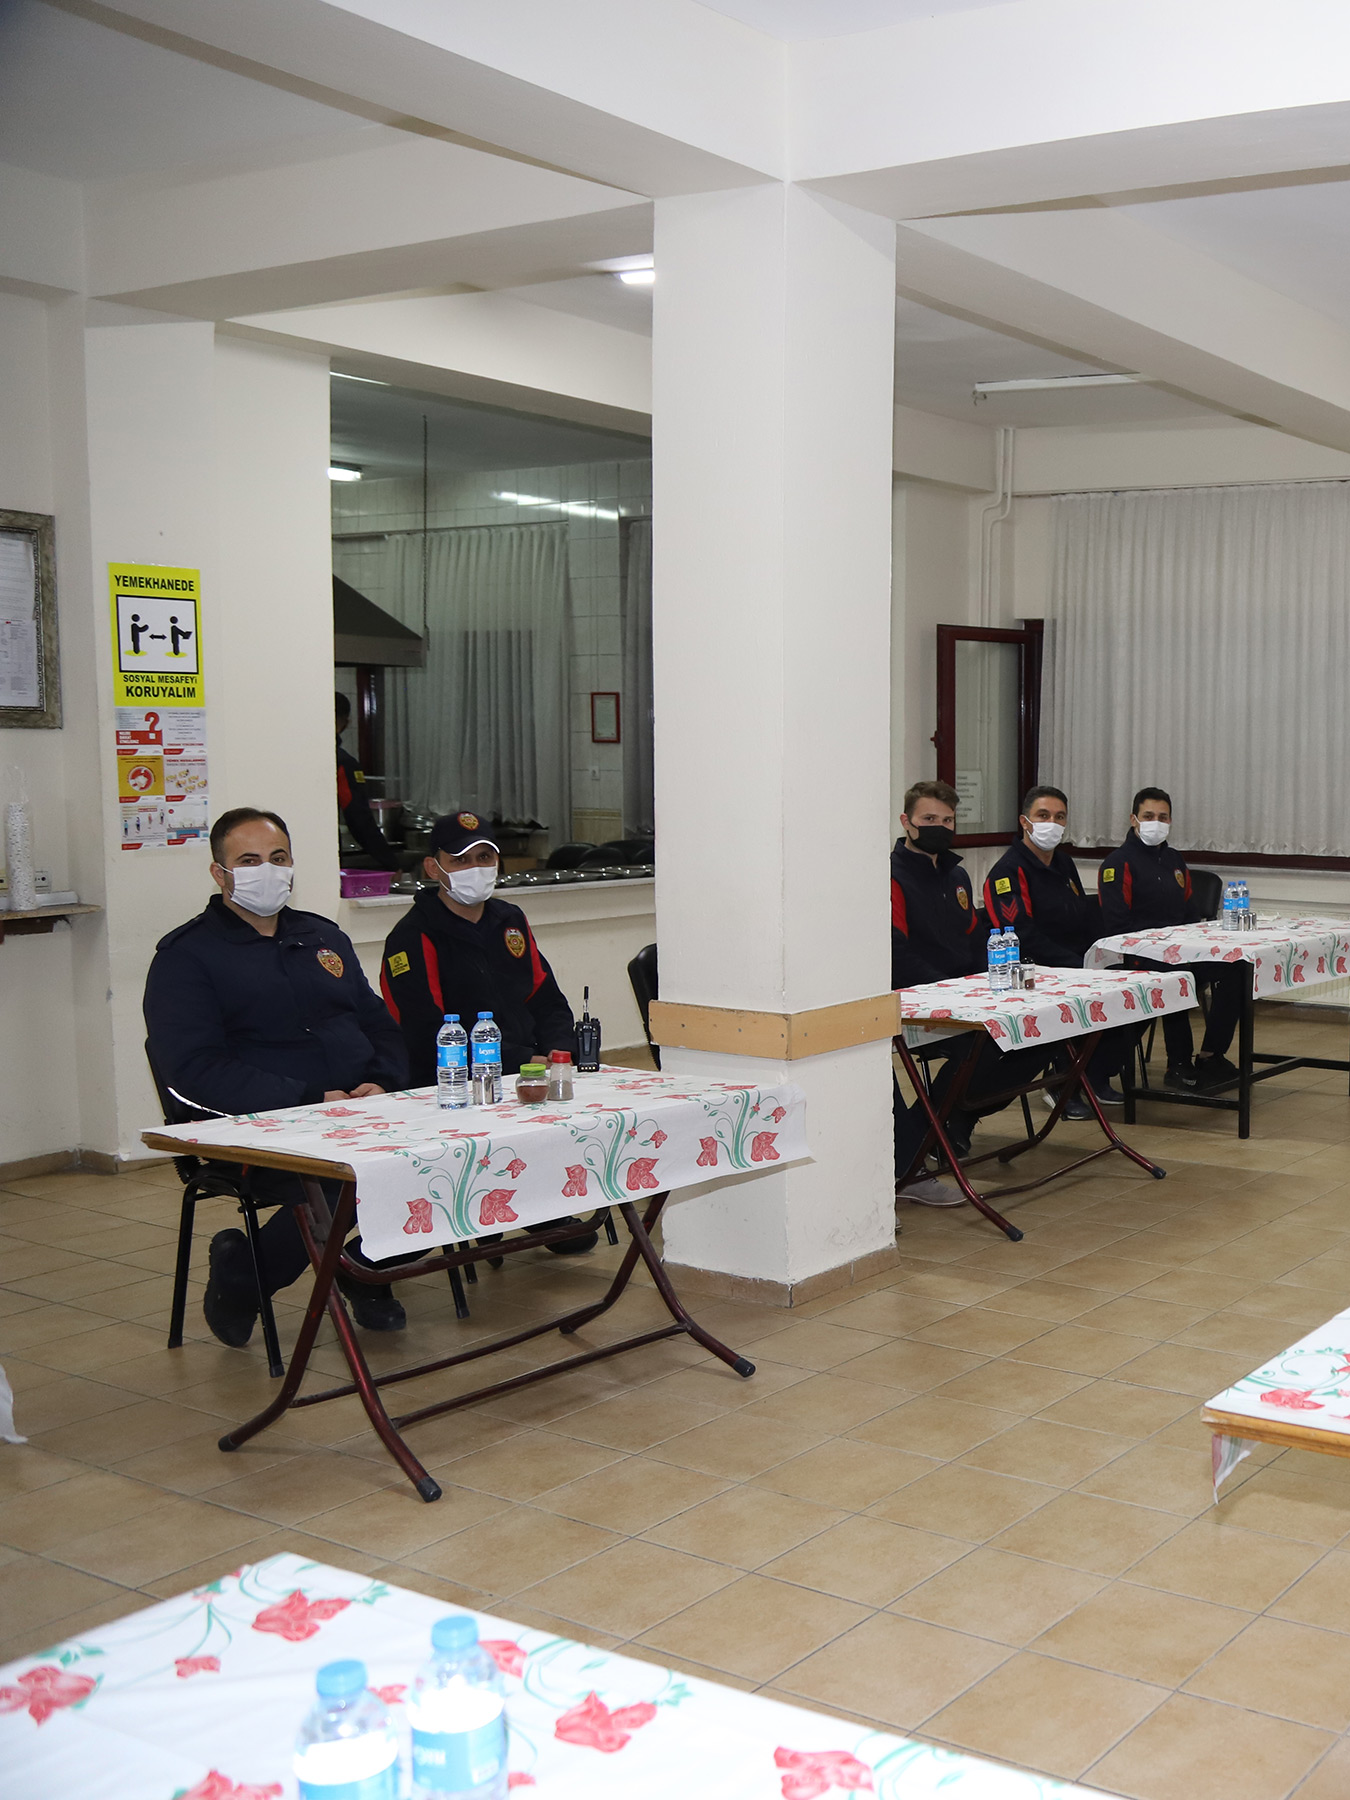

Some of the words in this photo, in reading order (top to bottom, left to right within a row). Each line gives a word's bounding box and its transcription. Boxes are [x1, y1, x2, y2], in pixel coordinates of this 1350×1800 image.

[114, 574, 195, 592] YEMEKHANEDE
[123, 674, 156, 684] SOSYAL
[125, 685, 196, 698] KORUYALIM
